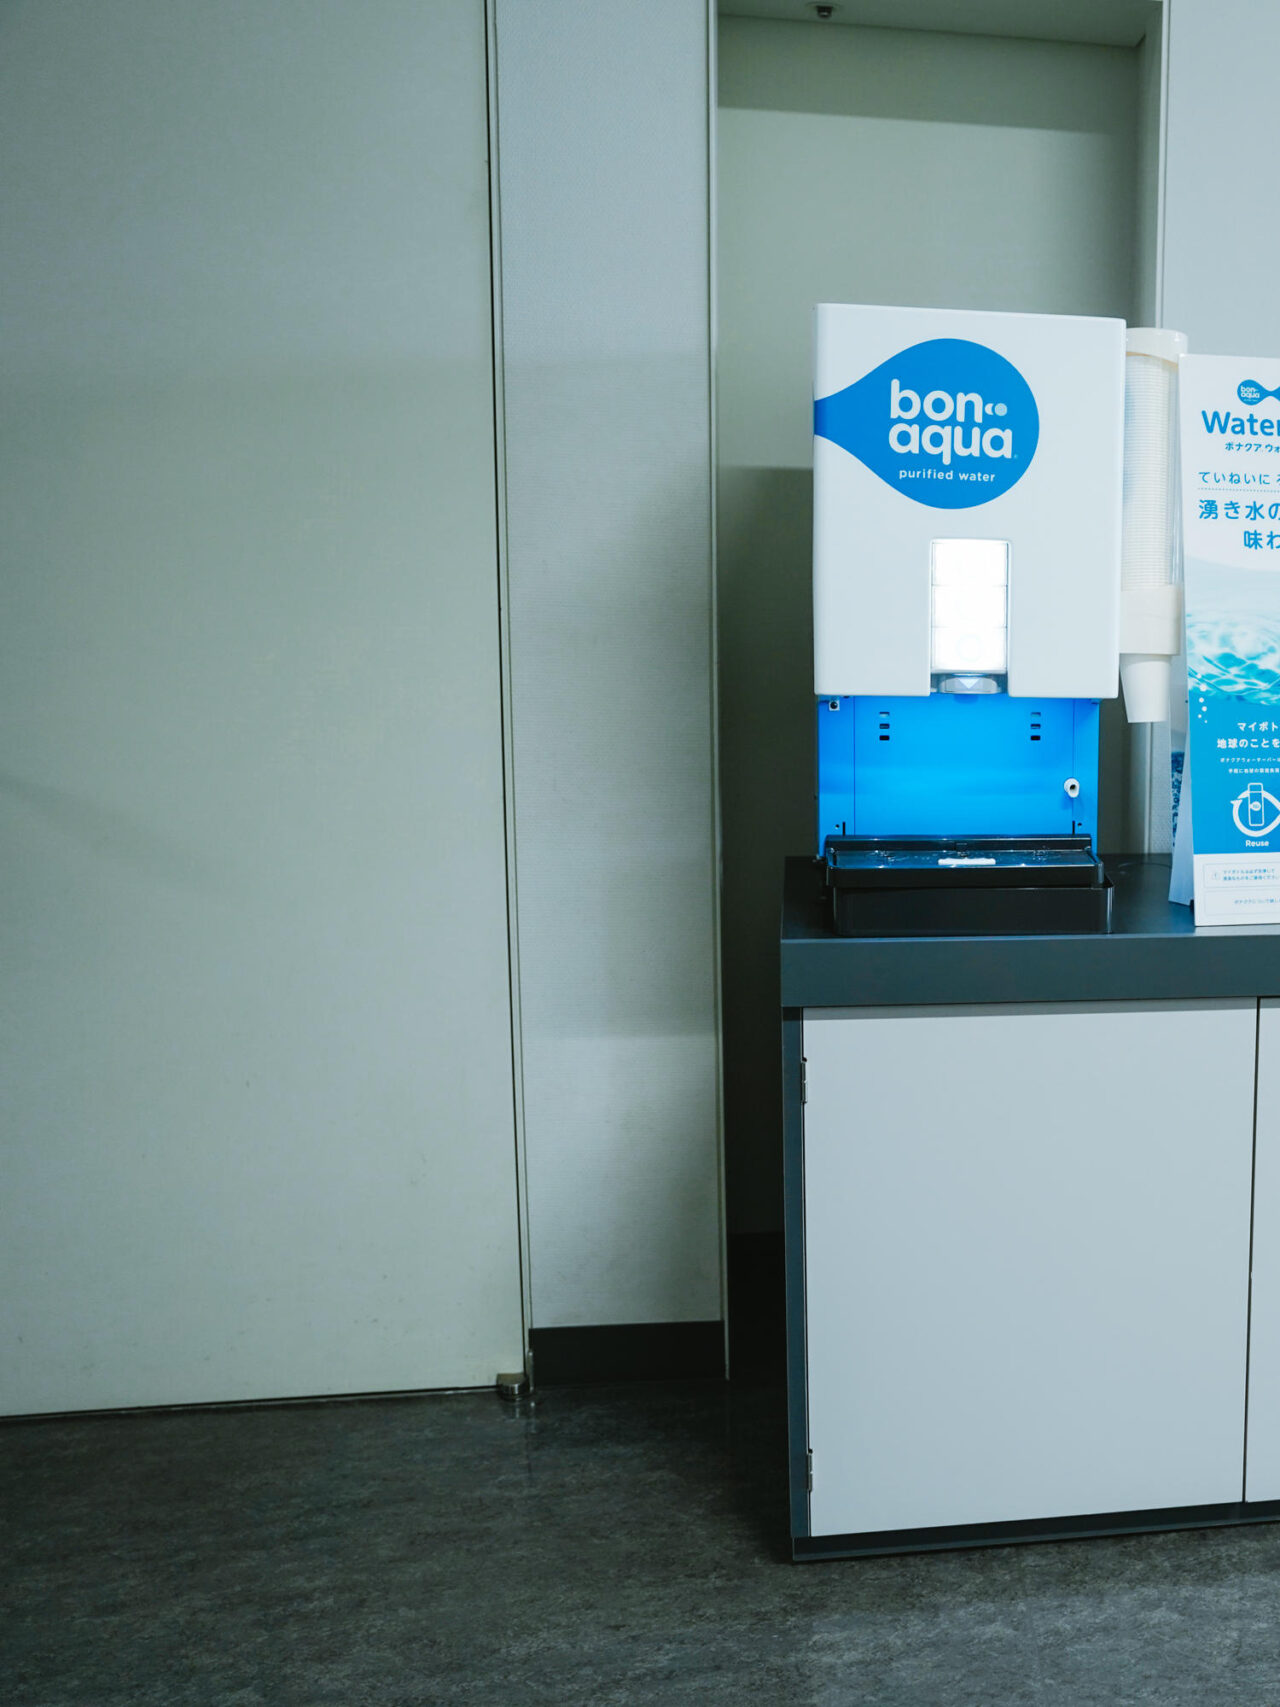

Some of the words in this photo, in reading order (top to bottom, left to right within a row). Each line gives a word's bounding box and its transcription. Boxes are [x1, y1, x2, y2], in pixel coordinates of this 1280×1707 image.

[888, 422, 1013, 466] aqua
[899, 468, 954, 481] purified
[959, 472, 996, 482] water
[1245, 839, 1269, 847] Reuse
